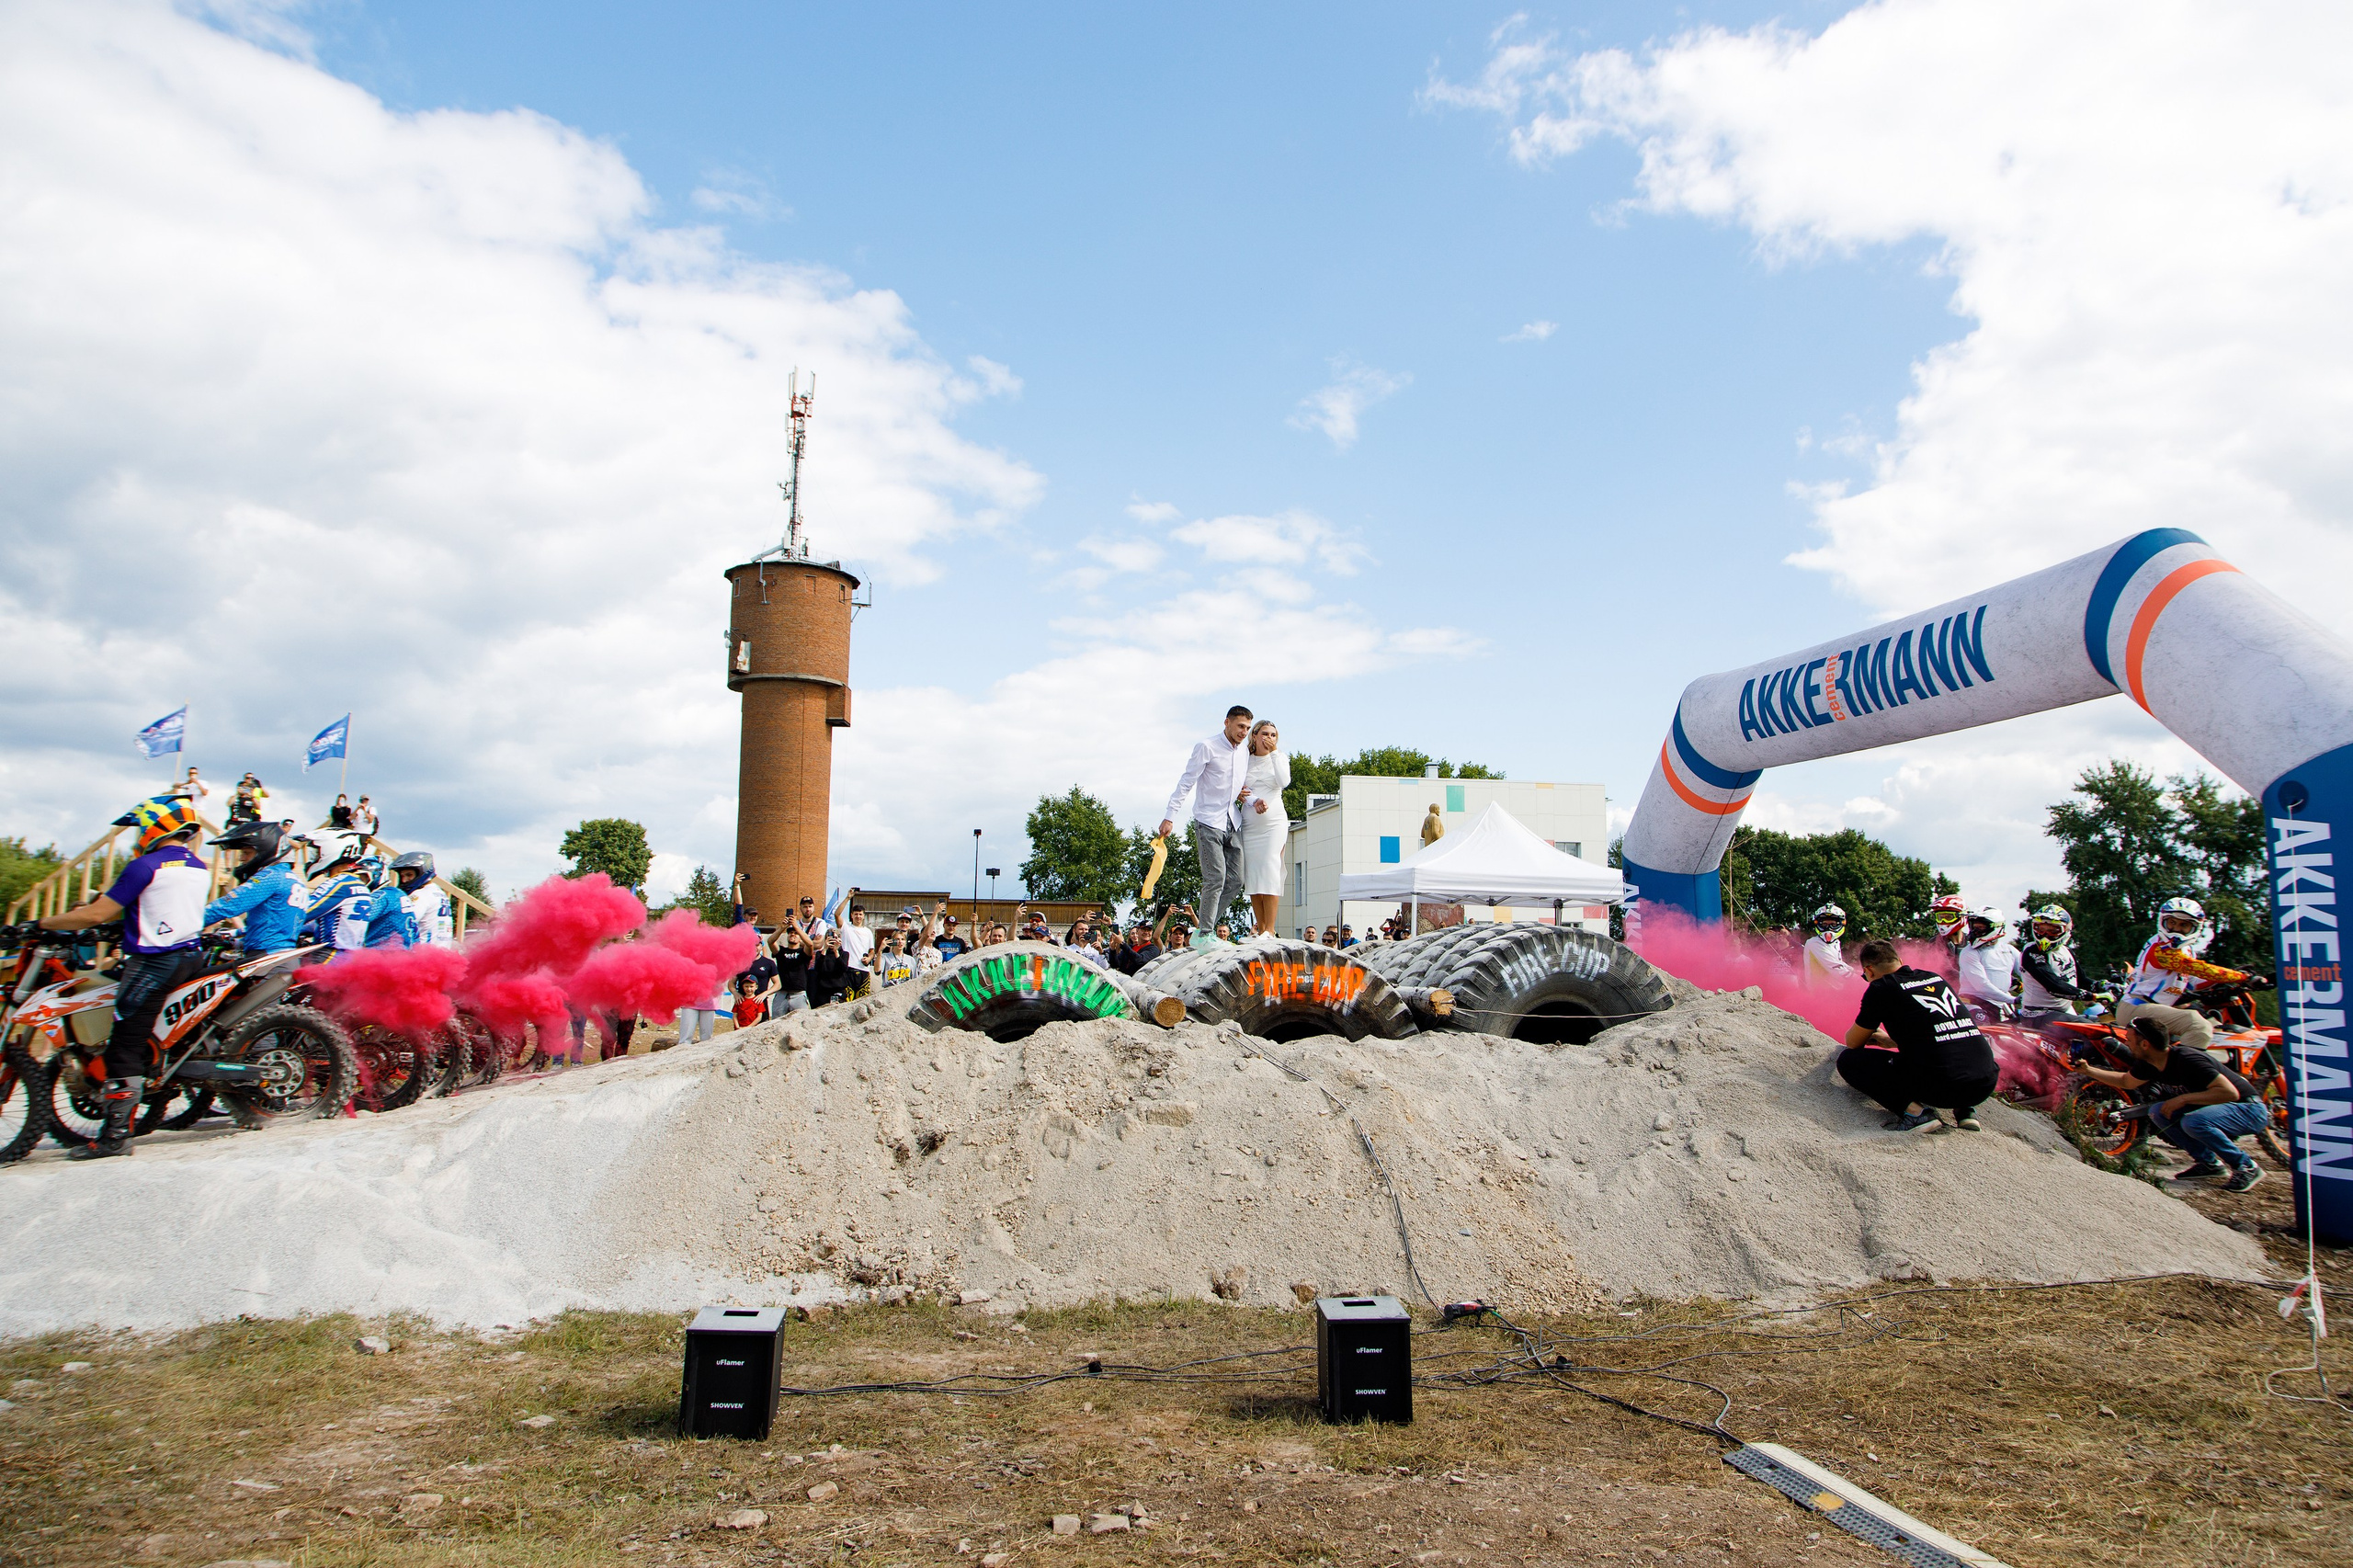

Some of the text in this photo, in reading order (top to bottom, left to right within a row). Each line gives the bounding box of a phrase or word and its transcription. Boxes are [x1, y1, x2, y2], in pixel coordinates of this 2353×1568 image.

[1739, 605, 1995, 742] AKKERMANN
[1826, 653, 1847, 722] cement
[1247, 960, 1365, 1002] FIRE CUP
[1500, 941, 1610, 998] FIRE CUP
[2283, 962, 2343, 981] cement
[2271, 817, 2353, 1181] AKKERMANN
[1933, 1017, 1975, 1033] ROYAL RACE
[1934, 1033, 1951, 1042] hard
